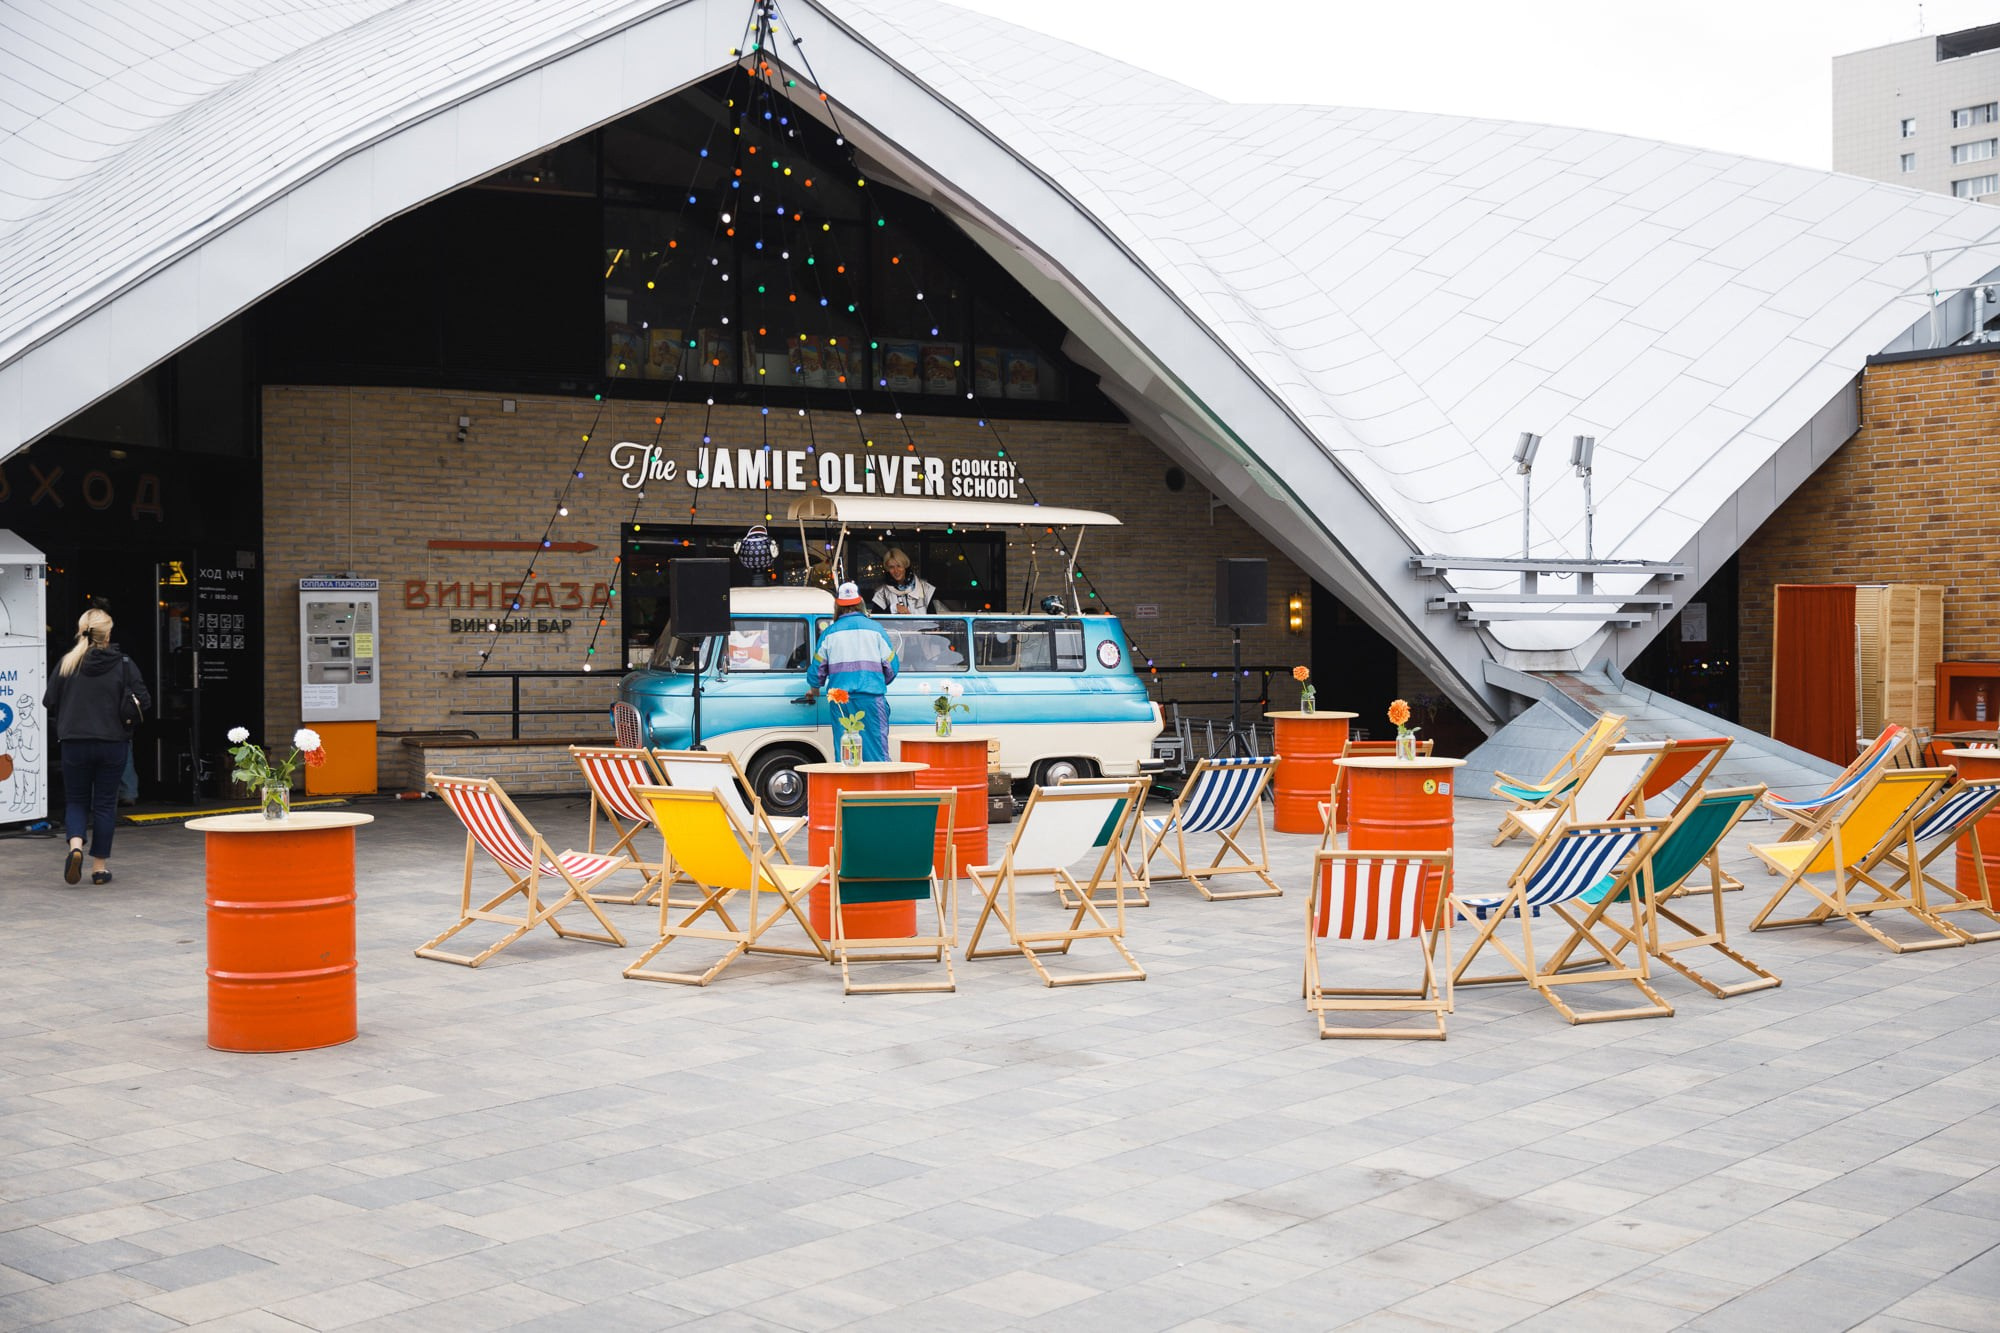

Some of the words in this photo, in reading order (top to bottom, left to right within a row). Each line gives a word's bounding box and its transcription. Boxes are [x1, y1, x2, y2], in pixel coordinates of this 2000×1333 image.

[610, 441, 678, 490] The
[687, 448, 806, 491] JAMIE
[819, 453, 946, 497] OLIVER
[951, 458, 1018, 478] COOKERY
[951, 478, 1018, 499] SCHOOL
[199, 568, 222, 580] ХОД
[302, 580, 333, 588] ОПЛАТА
[335, 580, 376, 588] ПАРКОВКИ
[404, 579, 615, 610] ВИНБАЗА
[450, 617, 531, 633] ВИННЫЙ
[537, 618, 572, 634] БАР
[0, 669, 18, 682] АМ
[0, 685, 14, 696] НЬ
